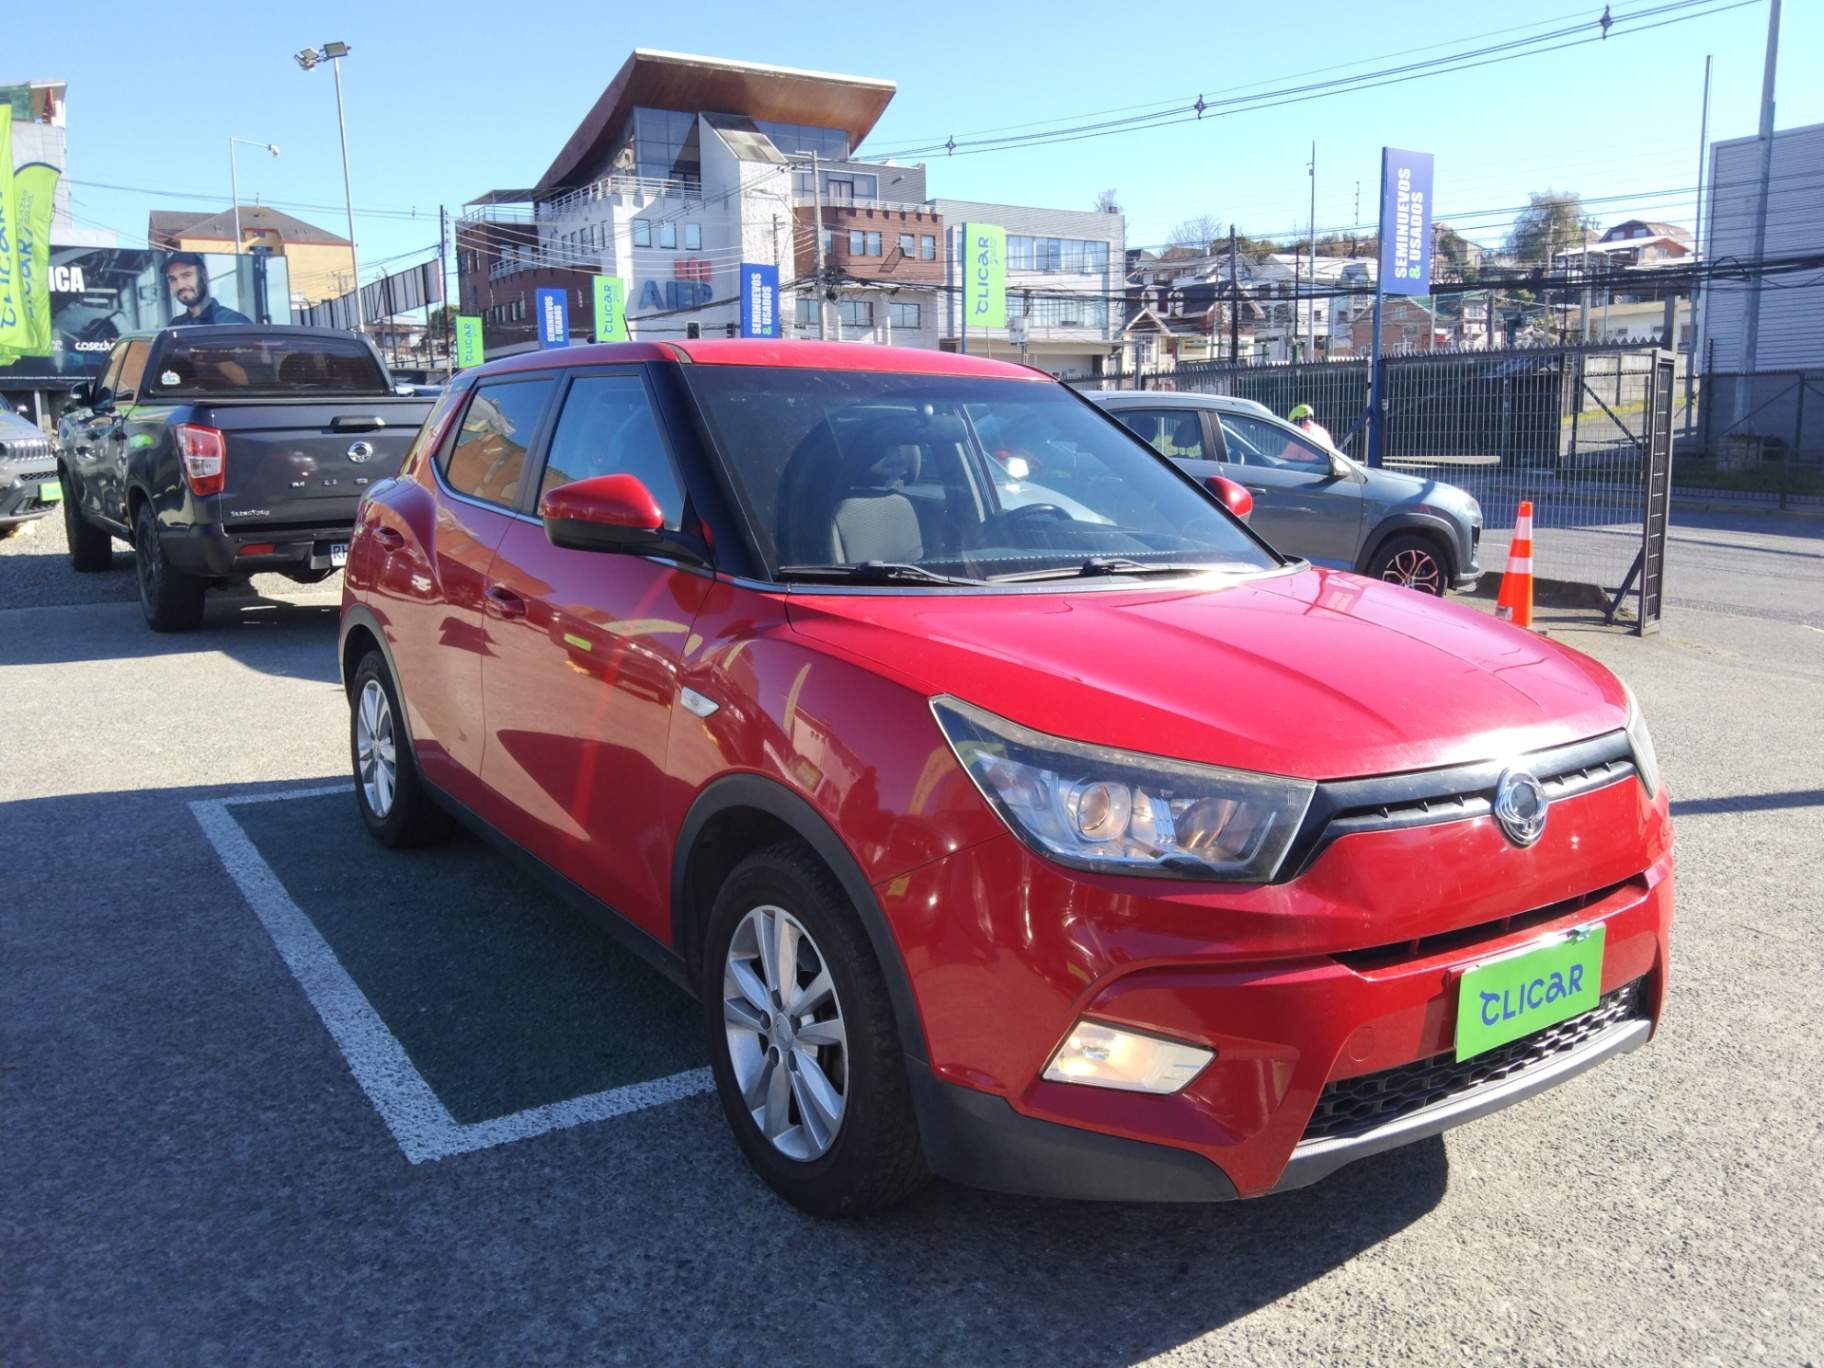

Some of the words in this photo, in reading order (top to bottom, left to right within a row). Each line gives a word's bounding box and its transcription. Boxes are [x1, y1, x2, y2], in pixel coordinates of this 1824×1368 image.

[1394, 168, 1411, 279] SEMINUEVOS
[1408, 192, 1424, 261] USADOS
[638, 280, 713, 311] AIEP
[752, 272, 762, 335] SEMINUEVOS
[1408, 265, 1422, 280] &
[762, 286, 772, 325] USADOS
[1479, 963, 1584, 1027] CLICAR
